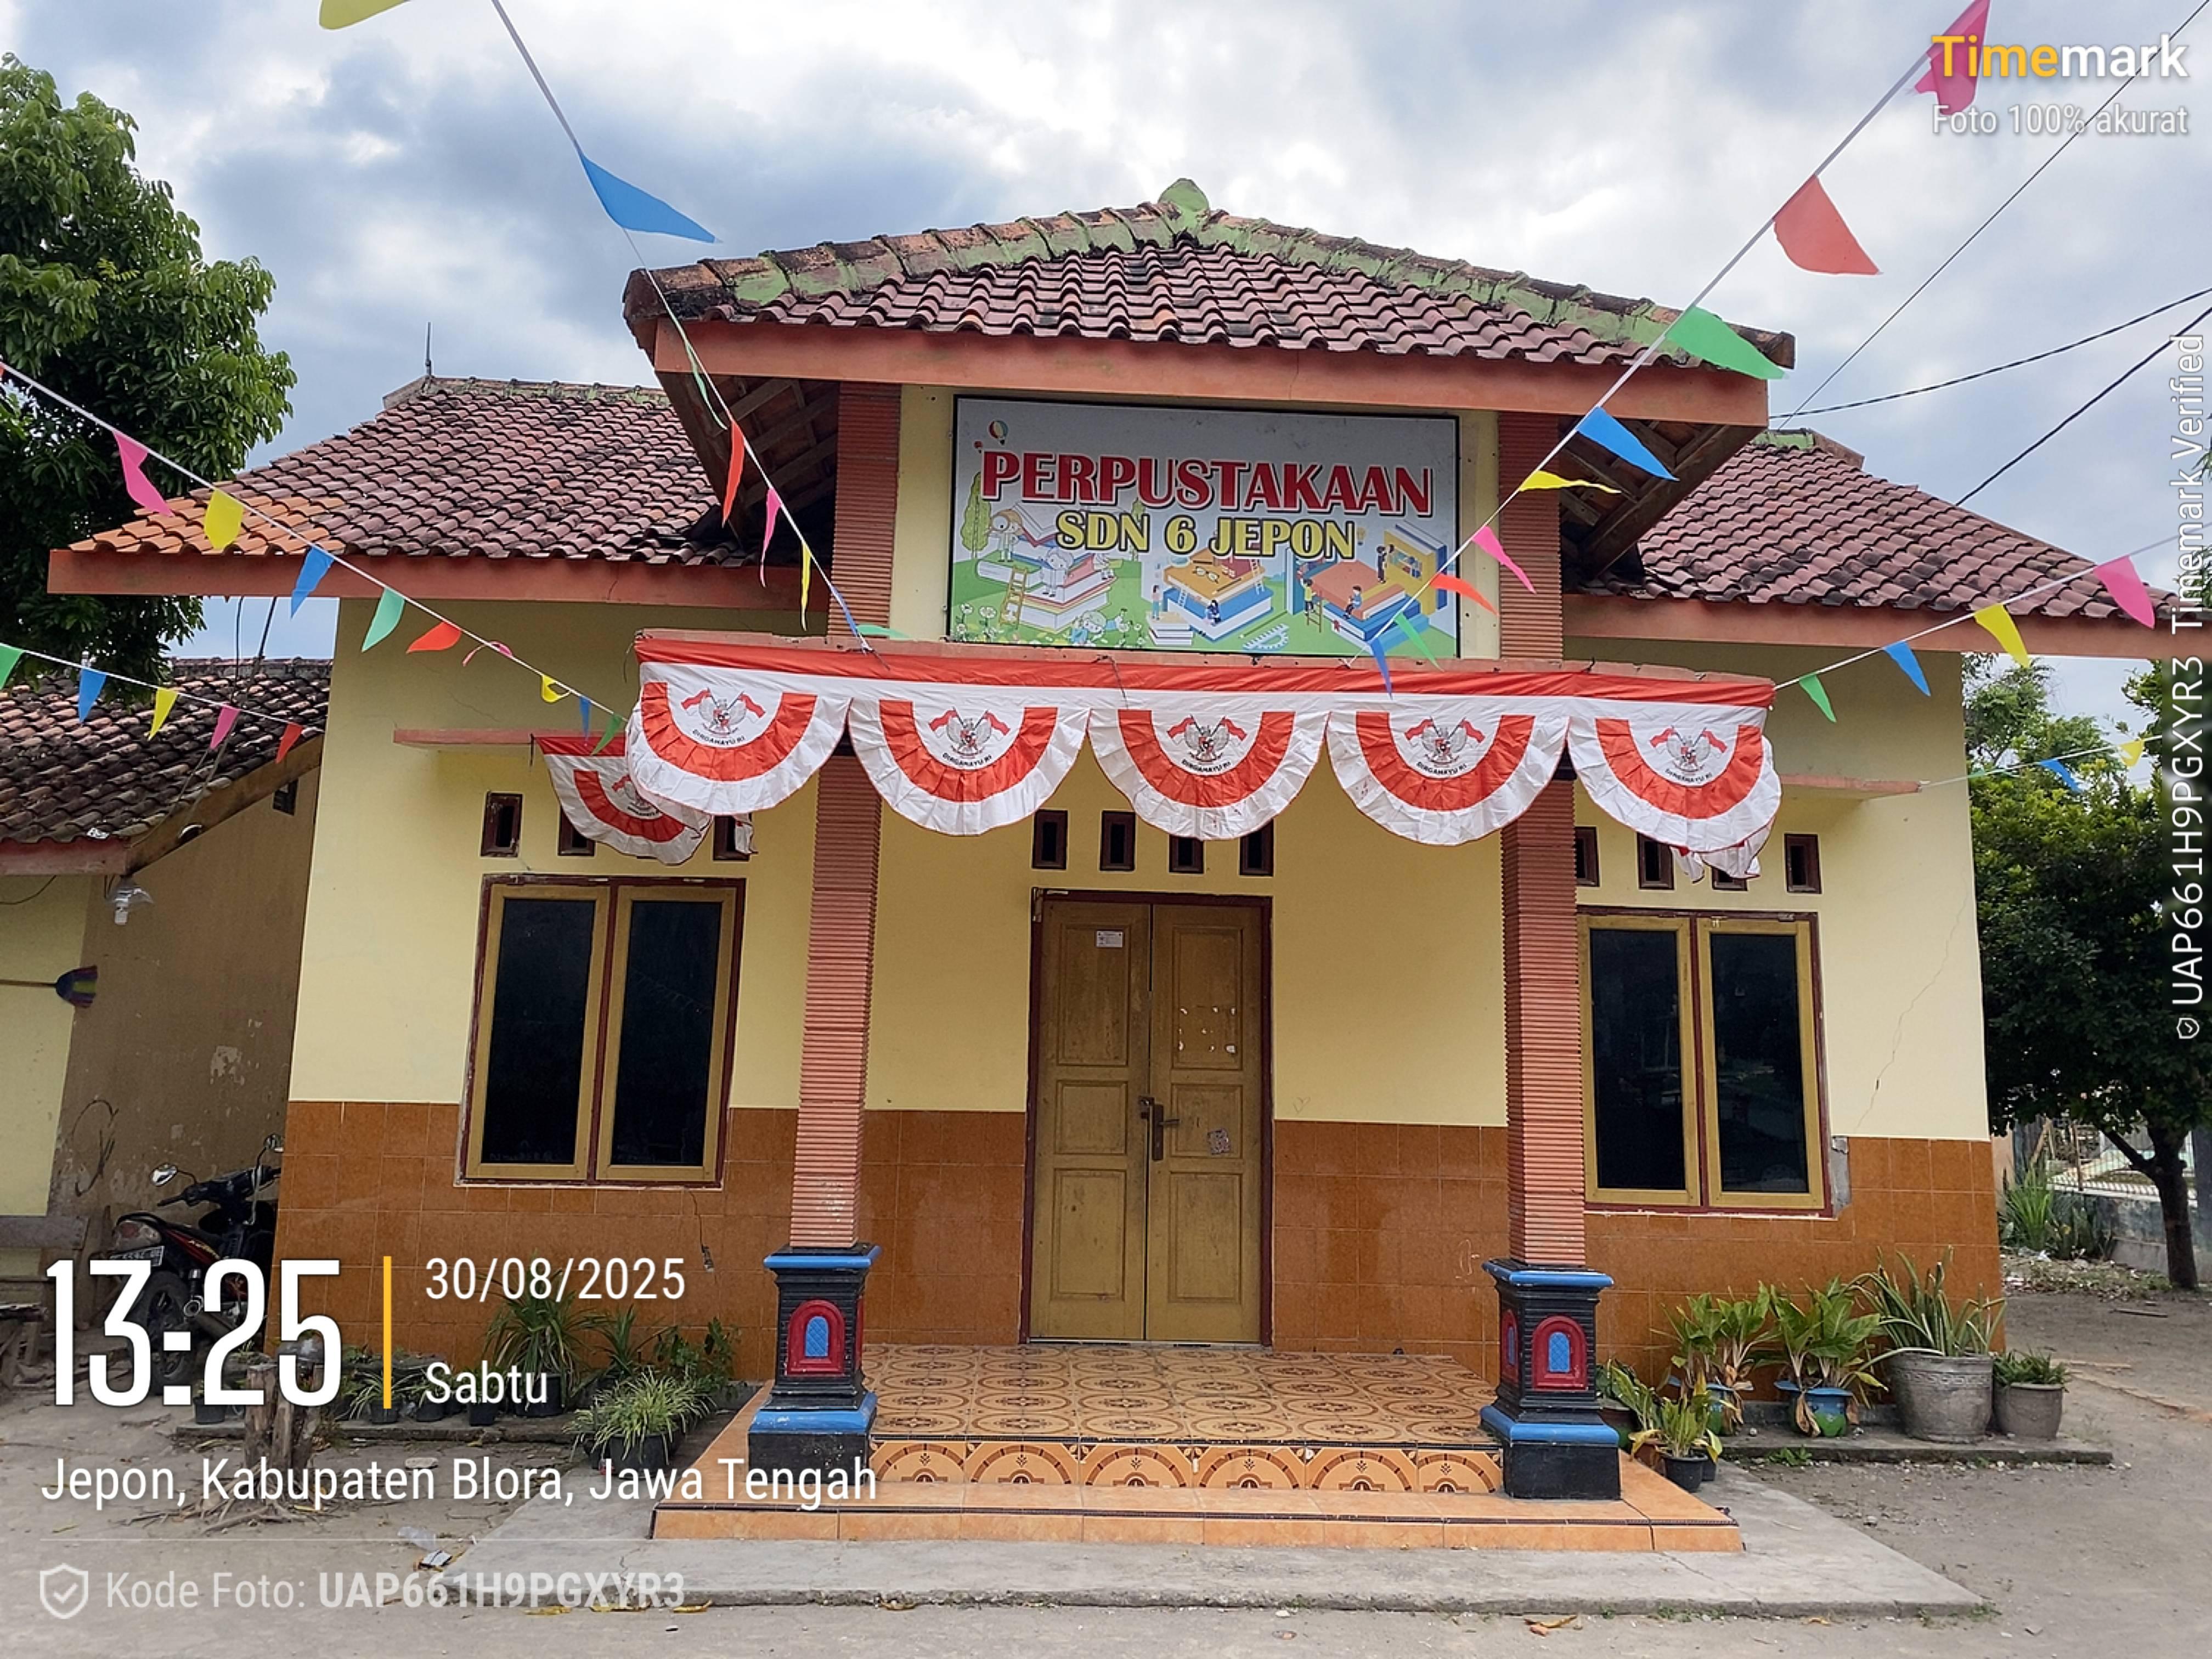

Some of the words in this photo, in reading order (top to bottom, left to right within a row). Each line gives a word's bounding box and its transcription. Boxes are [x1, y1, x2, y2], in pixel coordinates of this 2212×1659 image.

[982, 452, 1433, 516] PERPUSTAKAAN
[1056, 511, 1149, 552] SDN
[1165, 515, 1197, 554] 6
[1209, 518, 1355, 560] JEPON
